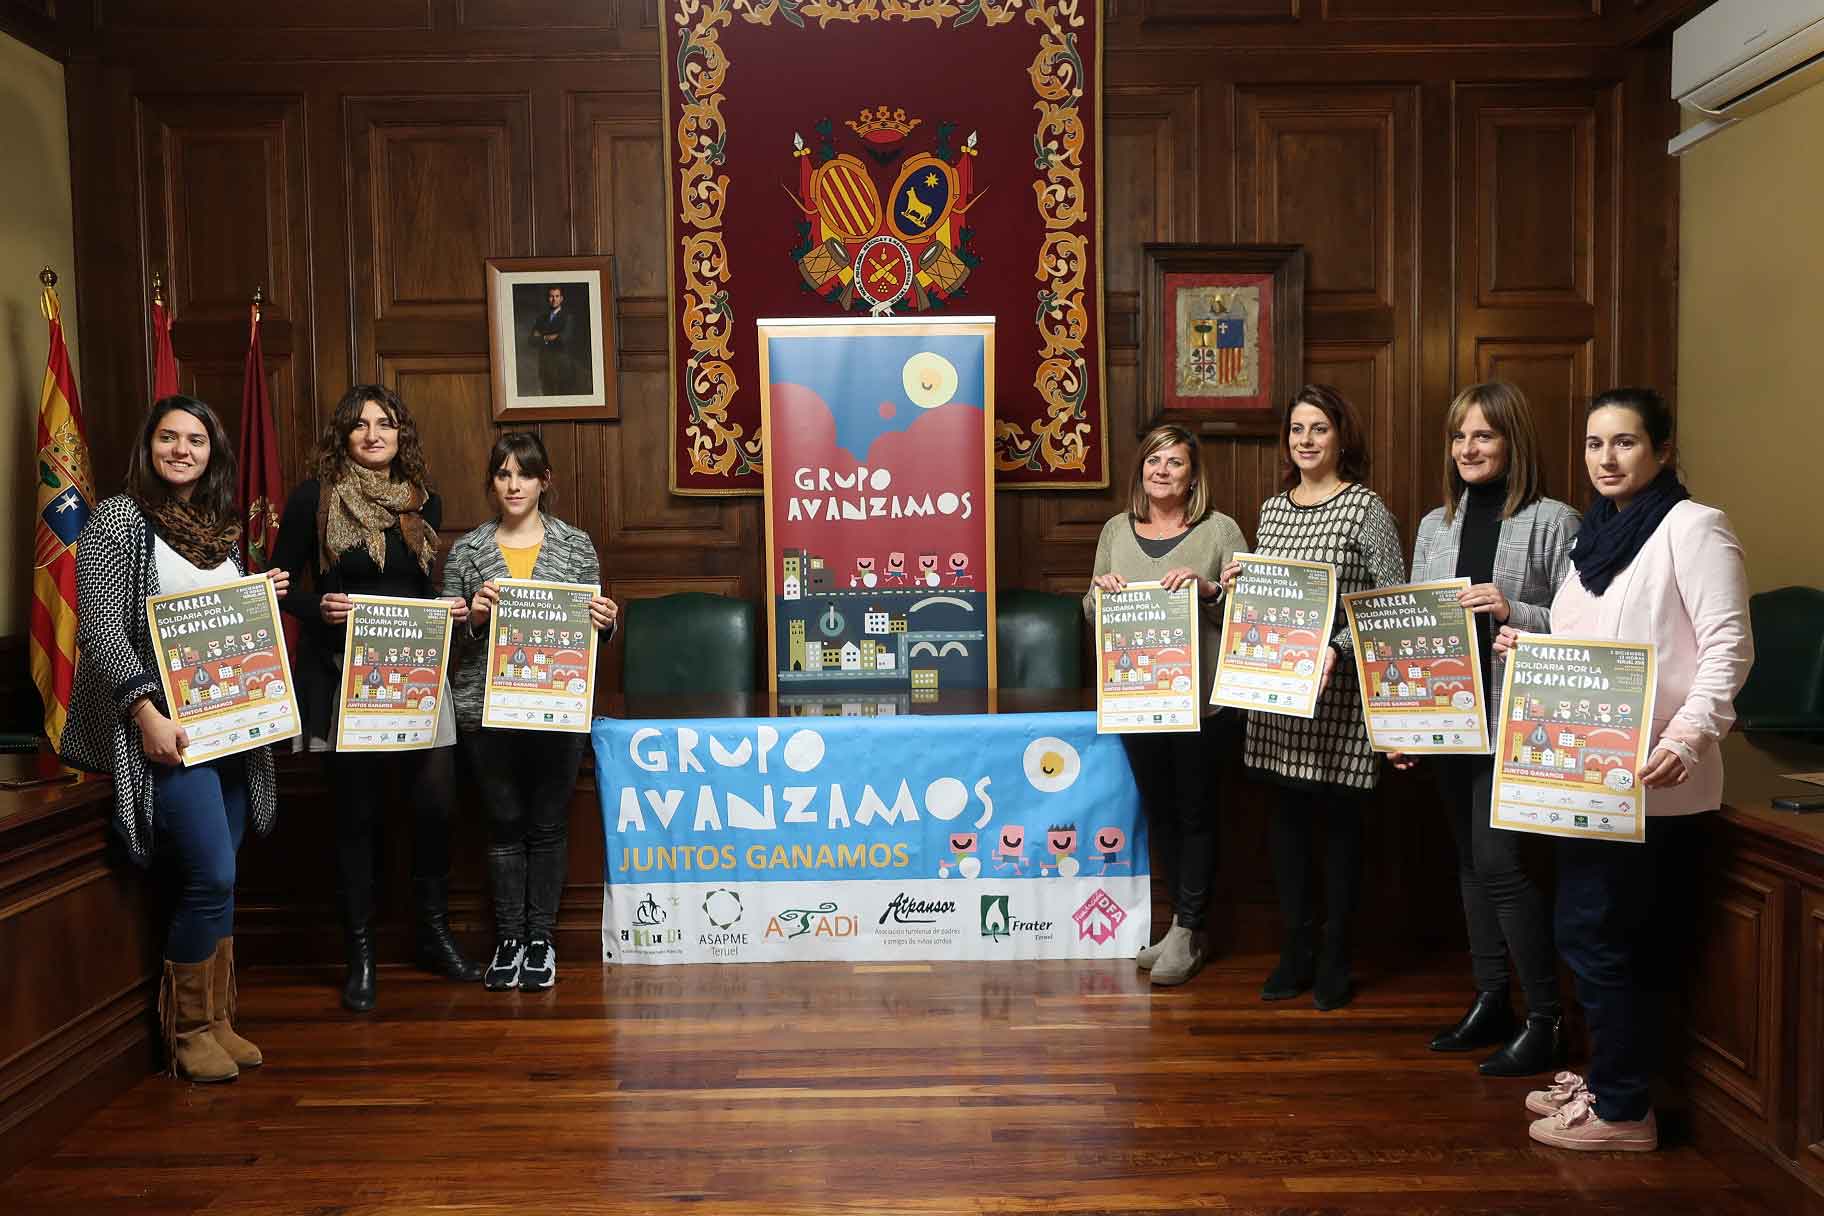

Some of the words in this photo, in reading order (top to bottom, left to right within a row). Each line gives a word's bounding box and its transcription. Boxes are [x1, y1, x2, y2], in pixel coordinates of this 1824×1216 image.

[794, 467, 891, 491] GRUPO
[788, 491, 972, 521] AVANZAMOS
[1248, 564, 1290, 577] CARRERA
[1236, 576, 1272, 585] SOLIDARIA
[510, 588, 553, 600] CARRERA
[1112, 592, 1151, 602] CARRERA
[1236, 584, 1304, 600] DISCAPACIDAD
[155, 602, 167, 610] XV
[169, 593, 222, 613] CARRERA
[500, 600, 536, 608] SOLIDARIA
[1365, 594, 1416, 608] CARRERA
[157, 612, 202, 626] SOLIDARIA
[204, 608, 221, 618] POR
[367, 606, 410, 618] CARRERA
[499, 607, 568, 622] DISCAPACIDAD
[1102, 611, 1166, 624] DISCAPACIDAD
[1356, 609, 1398, 618] SOLIDARIA
[160, 612, 244, 639] DISCAPACIDAD
[355, 617, 391, 626] SOLIDARIA
[1358, 615, 1437, 632] DISCAPACIDAD
[354, 625, 423, 640] DISCAPACIDAD
[1531, 648, 1590, 662] CARRERA
[1515, 661, 1564, 672] SOLIDARIA
[1567, 664, 1586, 673] POR
[1589, 666, 1602, 674] LA
[1514, 671, 1610, 690] DISCAPACIDAD
[628, 725, 826, 773] GRUPO
[616, 775, 993, 834] AVANZAMOS
[619, 843, 738, 873] JUNTOS
[746, 841, 910, 870] GANAMOS
[1099, 897, 1122, 922] DFA
[1013, 920, 1053, 931] Frater
[700, 933, 748, 944] ASAPME
[712, 946, 738, 957] Teruel
